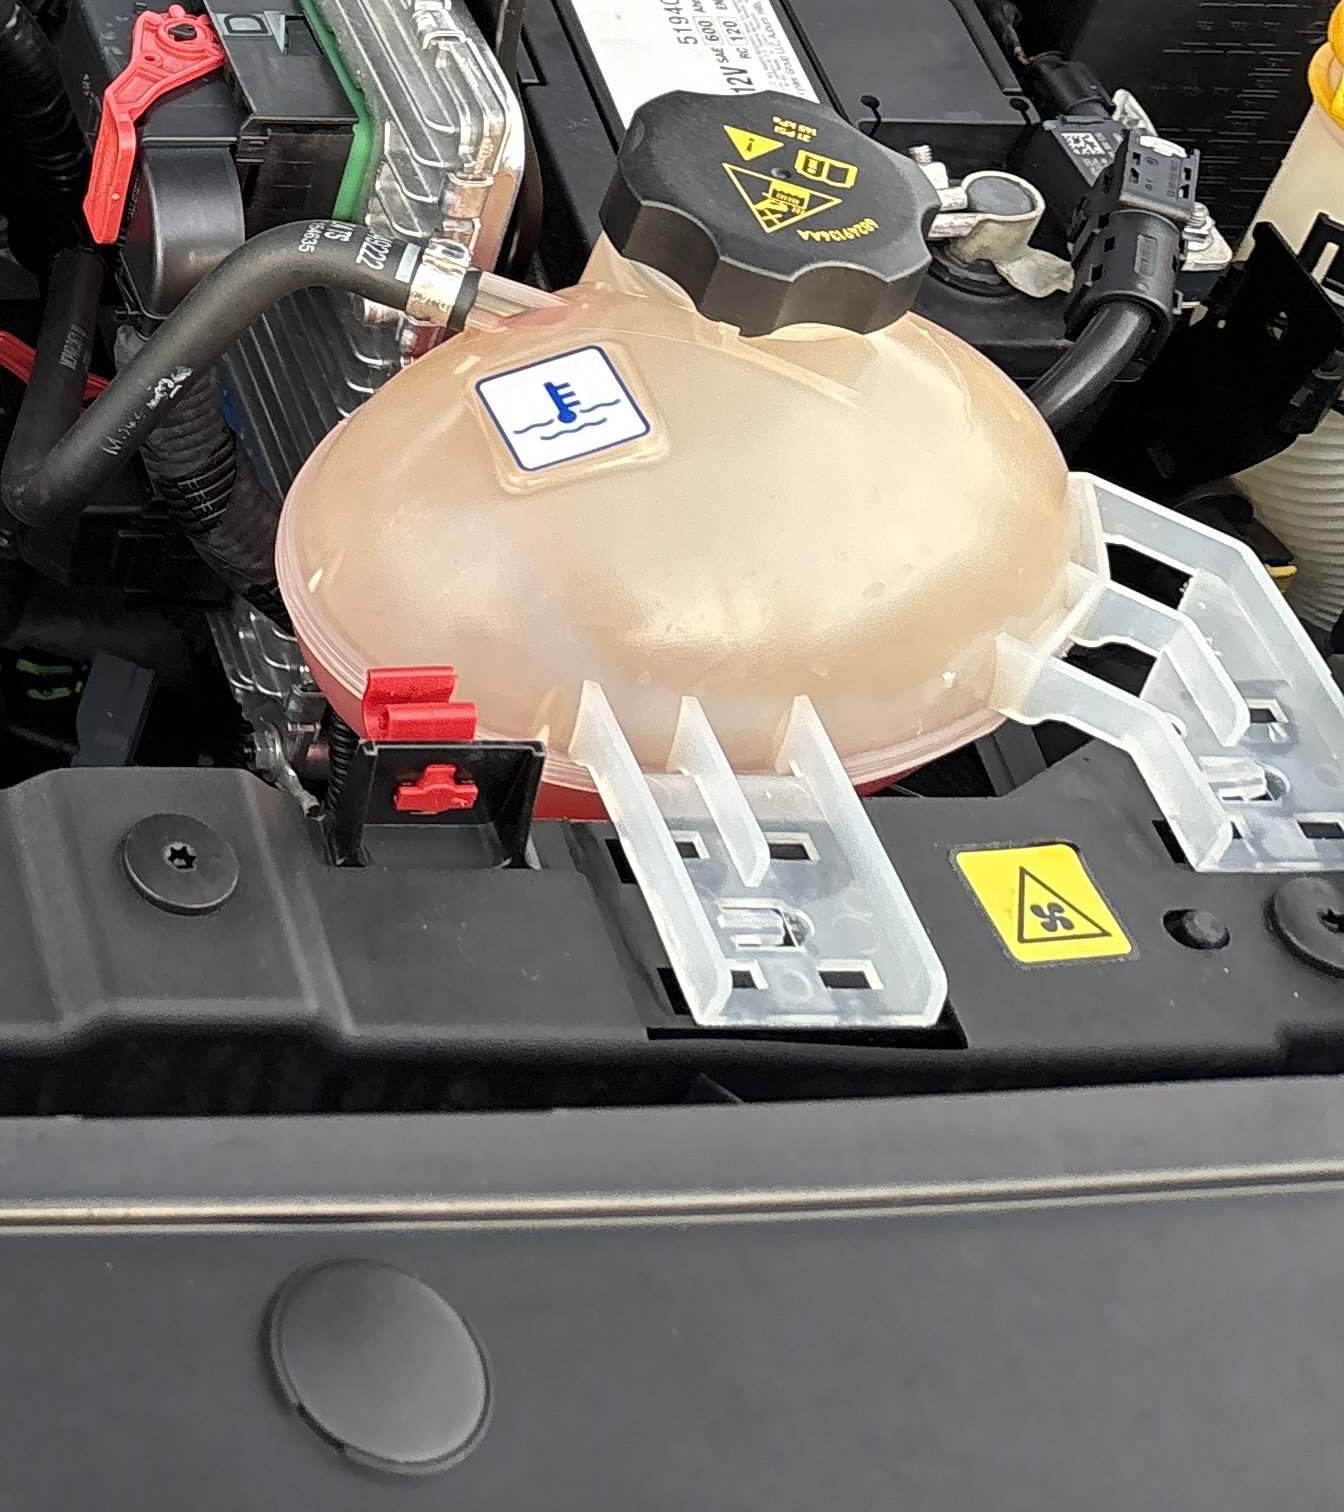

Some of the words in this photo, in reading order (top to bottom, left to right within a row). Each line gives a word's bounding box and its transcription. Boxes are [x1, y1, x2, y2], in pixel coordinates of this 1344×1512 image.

[697, 20, 720, 42] 600
[722, 20, 743, 42] 120
[719, 65, 757, 93] 12V
